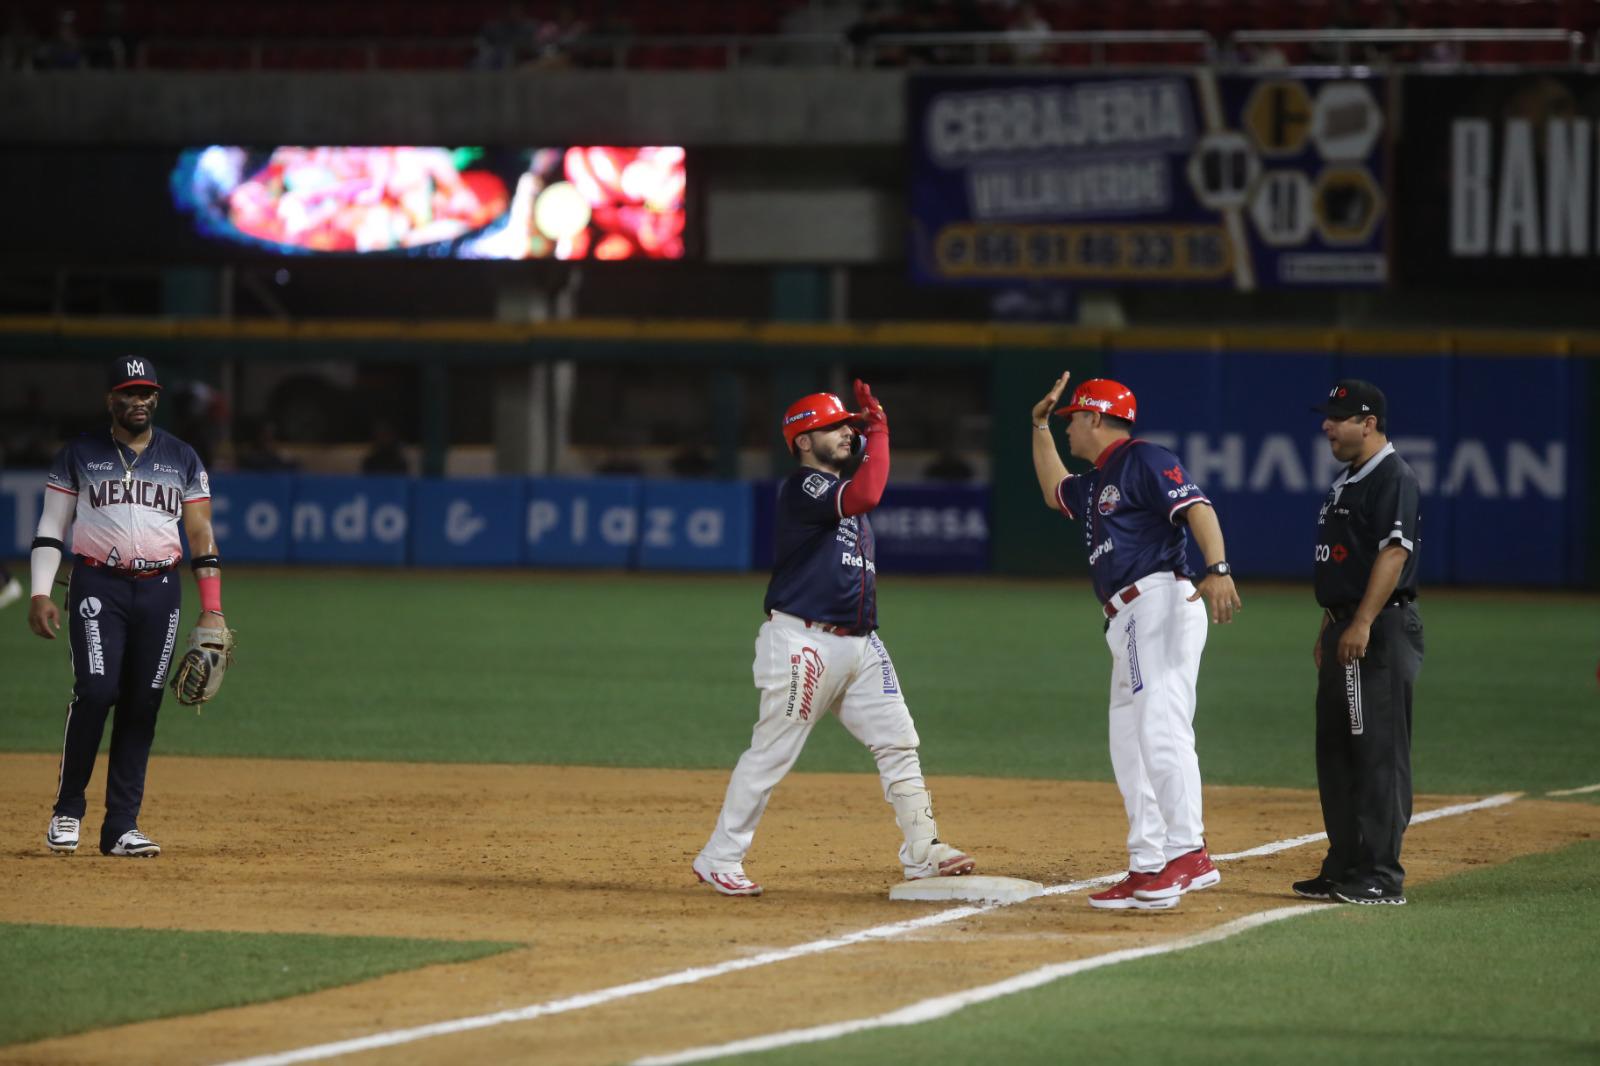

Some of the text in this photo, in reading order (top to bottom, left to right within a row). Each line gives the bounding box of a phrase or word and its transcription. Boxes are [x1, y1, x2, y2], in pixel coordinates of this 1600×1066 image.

[1450, 117, 1600, 257] BAN
[89, 480, 182, 516] MEXICALI
[444, 500, 486, 546] &
[526, 497, 725, 547] Plaza
[89, 620, 104, 675] INTRANSIT
[785, 664, 800, 717] caliente.mx
[799, 646, 825, 721] Caliente
[1345, 663, 1358, 725] PAQUETEXPRE
